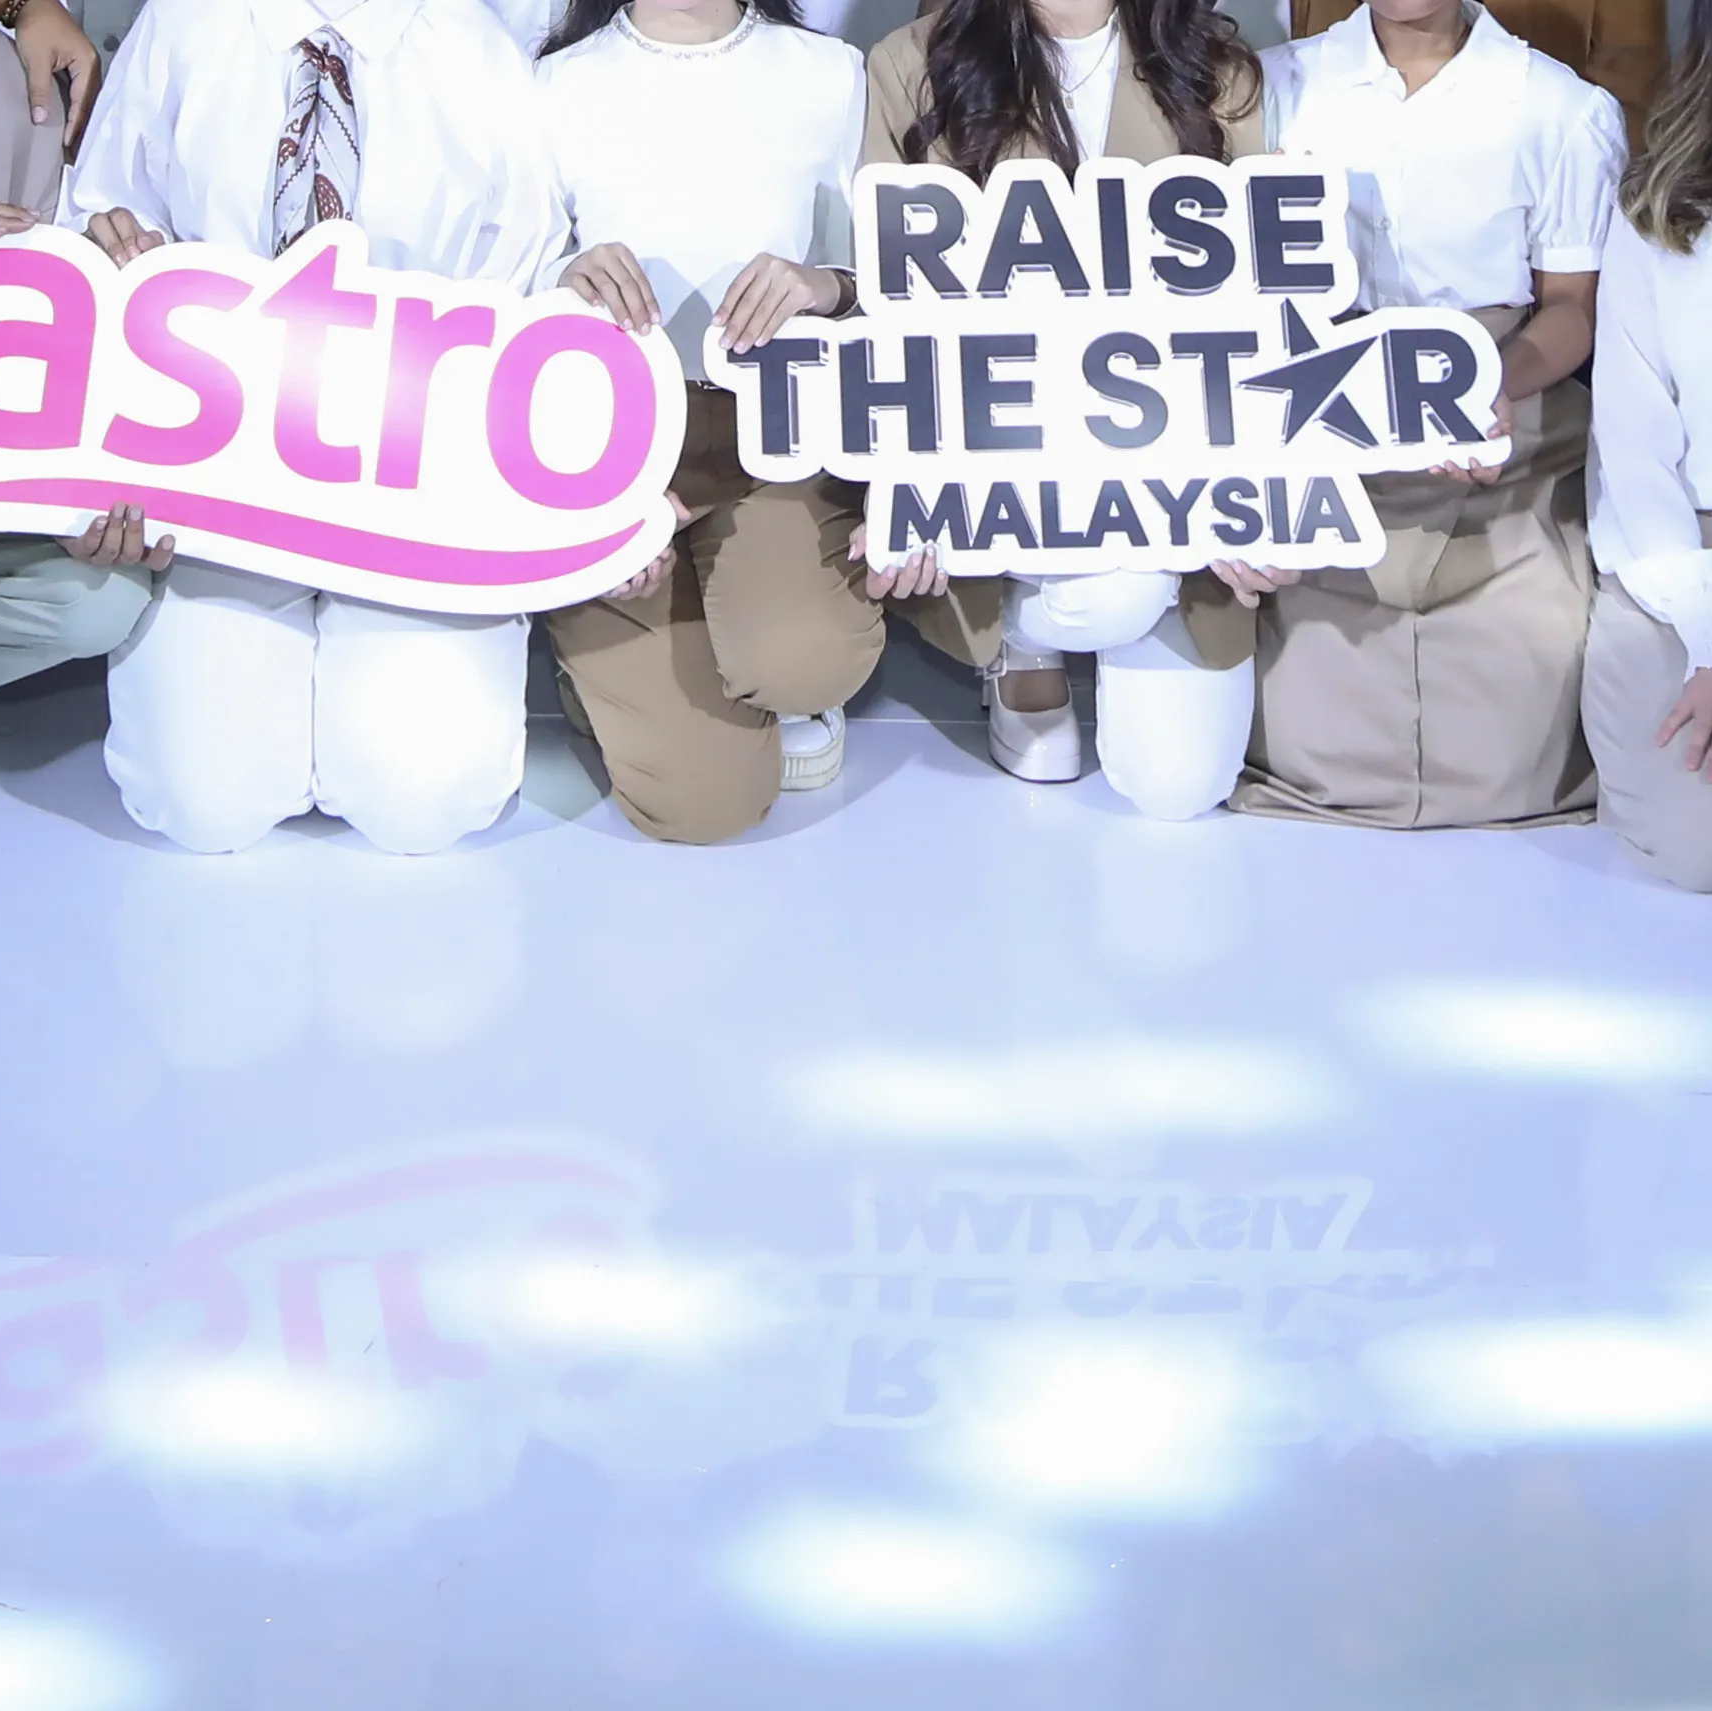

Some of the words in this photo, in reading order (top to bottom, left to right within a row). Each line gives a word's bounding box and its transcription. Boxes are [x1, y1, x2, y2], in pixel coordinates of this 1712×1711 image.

[875, 175, 1337, 299] RAISE
[726, 332, 1045, 457] THE
[888, 475, 1363, 552] MALAYSIA
